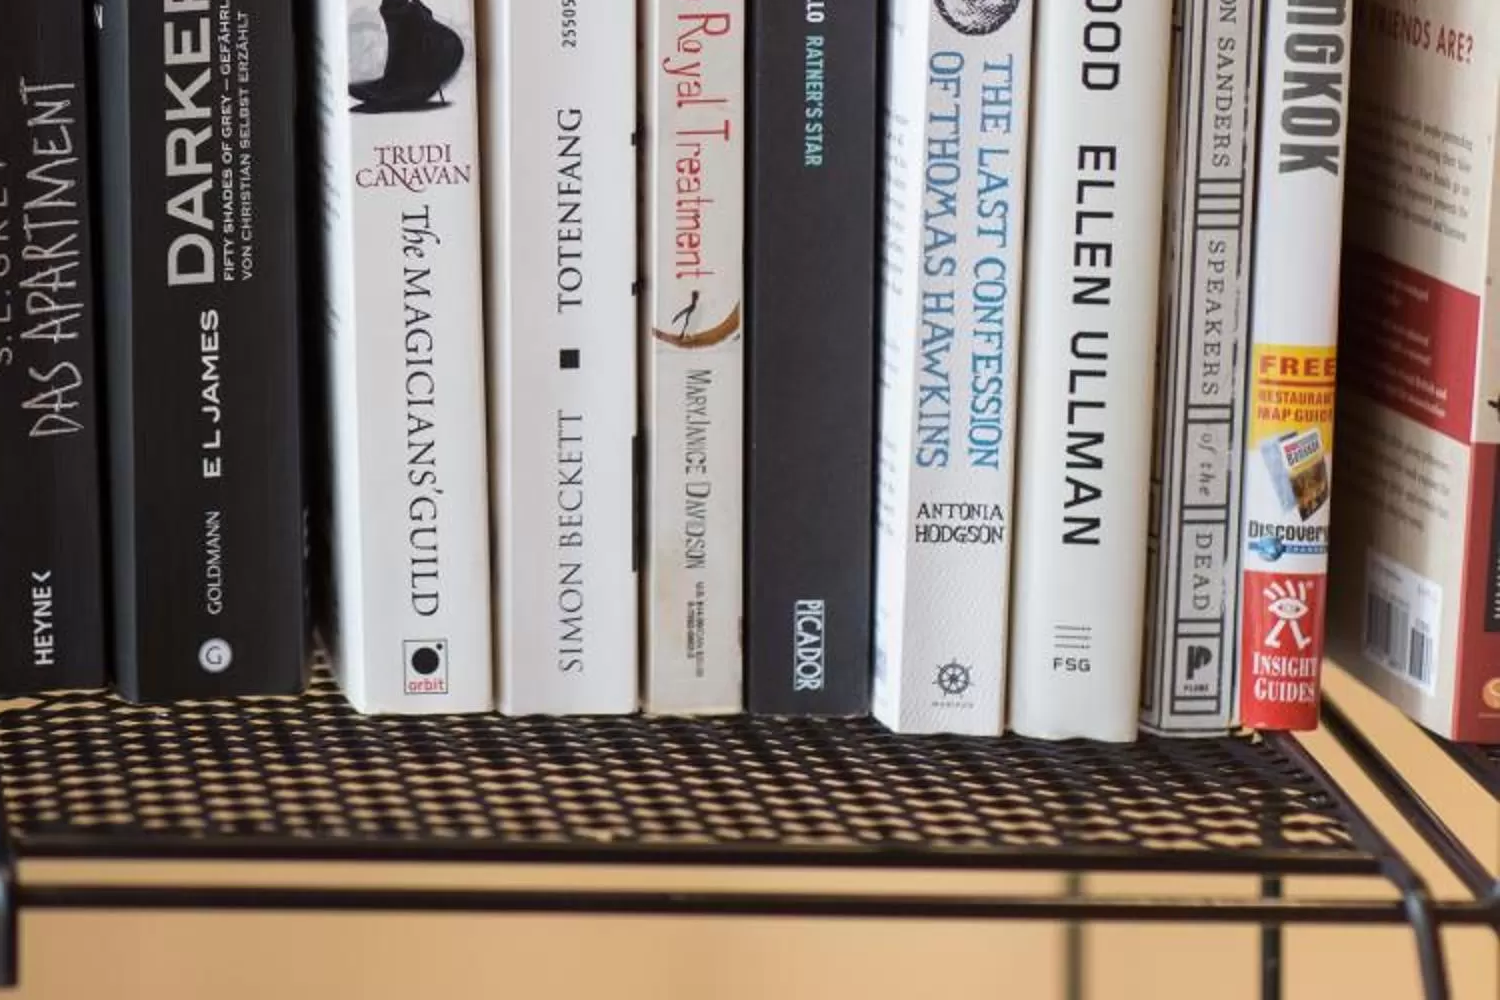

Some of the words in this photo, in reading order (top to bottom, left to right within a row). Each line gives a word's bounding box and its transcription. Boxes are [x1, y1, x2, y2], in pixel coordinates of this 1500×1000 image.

[662, 11, 732, 108] Royal
[927, 50, 965, 97] OF
[1435, 23, 1475, 65] ARE?
[221, 92, 234, 139] GREY
[981, 53, 1013, 135] THE
[1212, 37, 1236, 170] SANDERS
[222, 142, 235, 163] OF
[355, 164, 472, 193] CANAVAN
[373, 144, 453, 167] TRUDI
[803, 120, 823, 167] STAR
[18, 75, 86, 344] APARTMENT
[223, 164, 236, 235] SHADES
[240, 152, 253, 244] CHRISTIAN
[400, 204, 442, 260] The
[556, 107, 583, 313] TOTENFANG
[674, 118, 731, 281] Treatment
[922, 105, 961, 279] THOMAS
[976, 148, 1011, 249] LAST
[1073, 145, 1117, 305] ELLEN
[222, 238, 236, 282] FIFTY
[241, 246, 254, 281] VON
[1200, 241, 1226, 398] SPEAKERS
[21, 359, 86, 438] DAS
[199, 307, 221, 423] JAMES
[916, 292, 957, 470] HAWKINS
[968, 256, 1008, 471] CONFESSION
[1259, 355, 1336, 377] FREE
[202, 428, 222, 450] L
[202, 456, 222, 478] E
[557, 408, 585, 549] BECKETT
[1061, 331, 1109, 547] ULLMAN
[915, 524, 1005, 545] HODGSON
[916, 502, 1005, 521] ANTONIA
[206, 509, 222, 616] GOLDMANN
[407, 494, 440, 618] GUILD
[1190, 531, 1214, 614] DEAD
[557, 562, 585, 674] SIMON
[794, 599, 825, 691] PICADOR
[407, 677, 445, 693] orbit
[1052, 657, 1092, 673] FSG
[1251, 651, 1318, 677] INSIGHT
[1253, 677, 1316, 702] GUIDES
